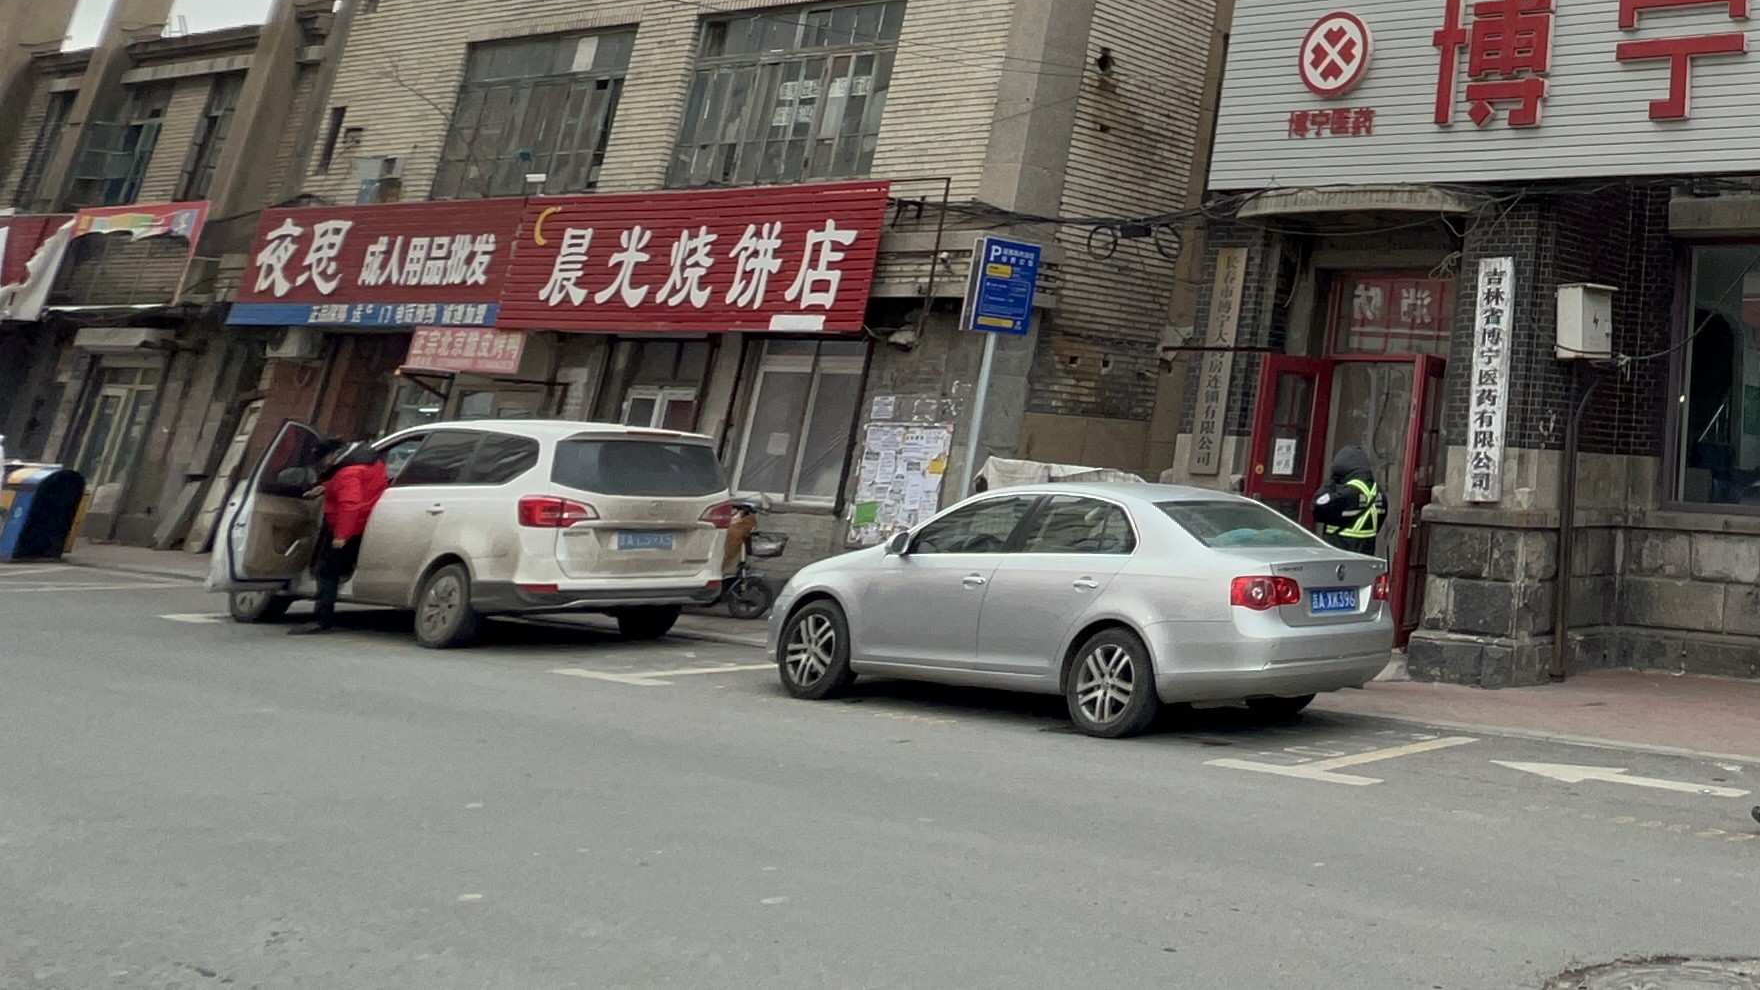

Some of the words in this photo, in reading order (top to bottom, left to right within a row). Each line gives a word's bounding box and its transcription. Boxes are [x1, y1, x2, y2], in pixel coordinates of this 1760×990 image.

[1287, 107, 1376, 139] 博宁医药
[253, 217, 354, 298] 夜思
[357, 232, 497, 287] 成人用品批发
[538, 218, 859, 310] 晨光烧饼店
[1471, 267, 1508, 491] 吉林省博宁医药有限公司
